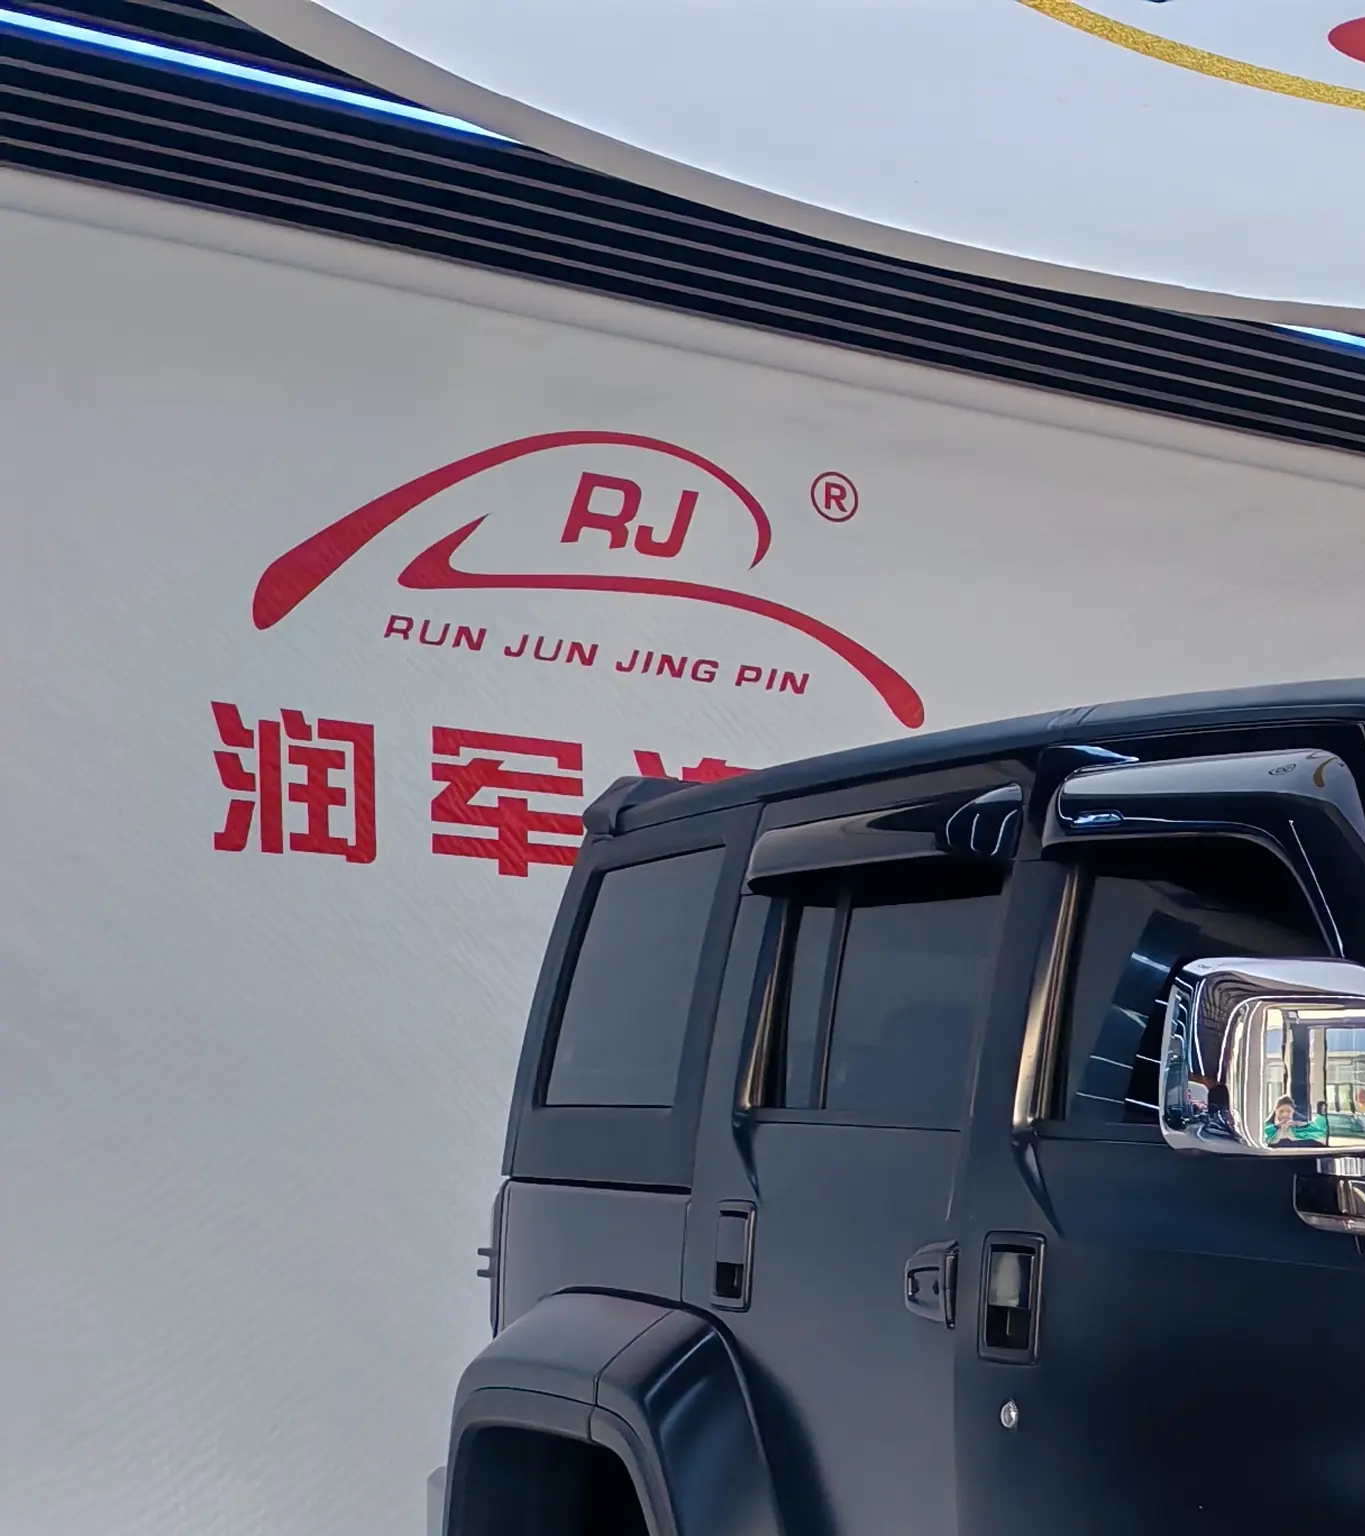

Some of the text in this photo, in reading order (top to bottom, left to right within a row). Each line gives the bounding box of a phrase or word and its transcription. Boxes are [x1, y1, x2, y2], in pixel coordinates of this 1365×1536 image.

[561, 471, 699, 558] RJ
[384, 614, 811, 695] RUN JUN JING PIN
[210, 700, 752, 878] 润军
